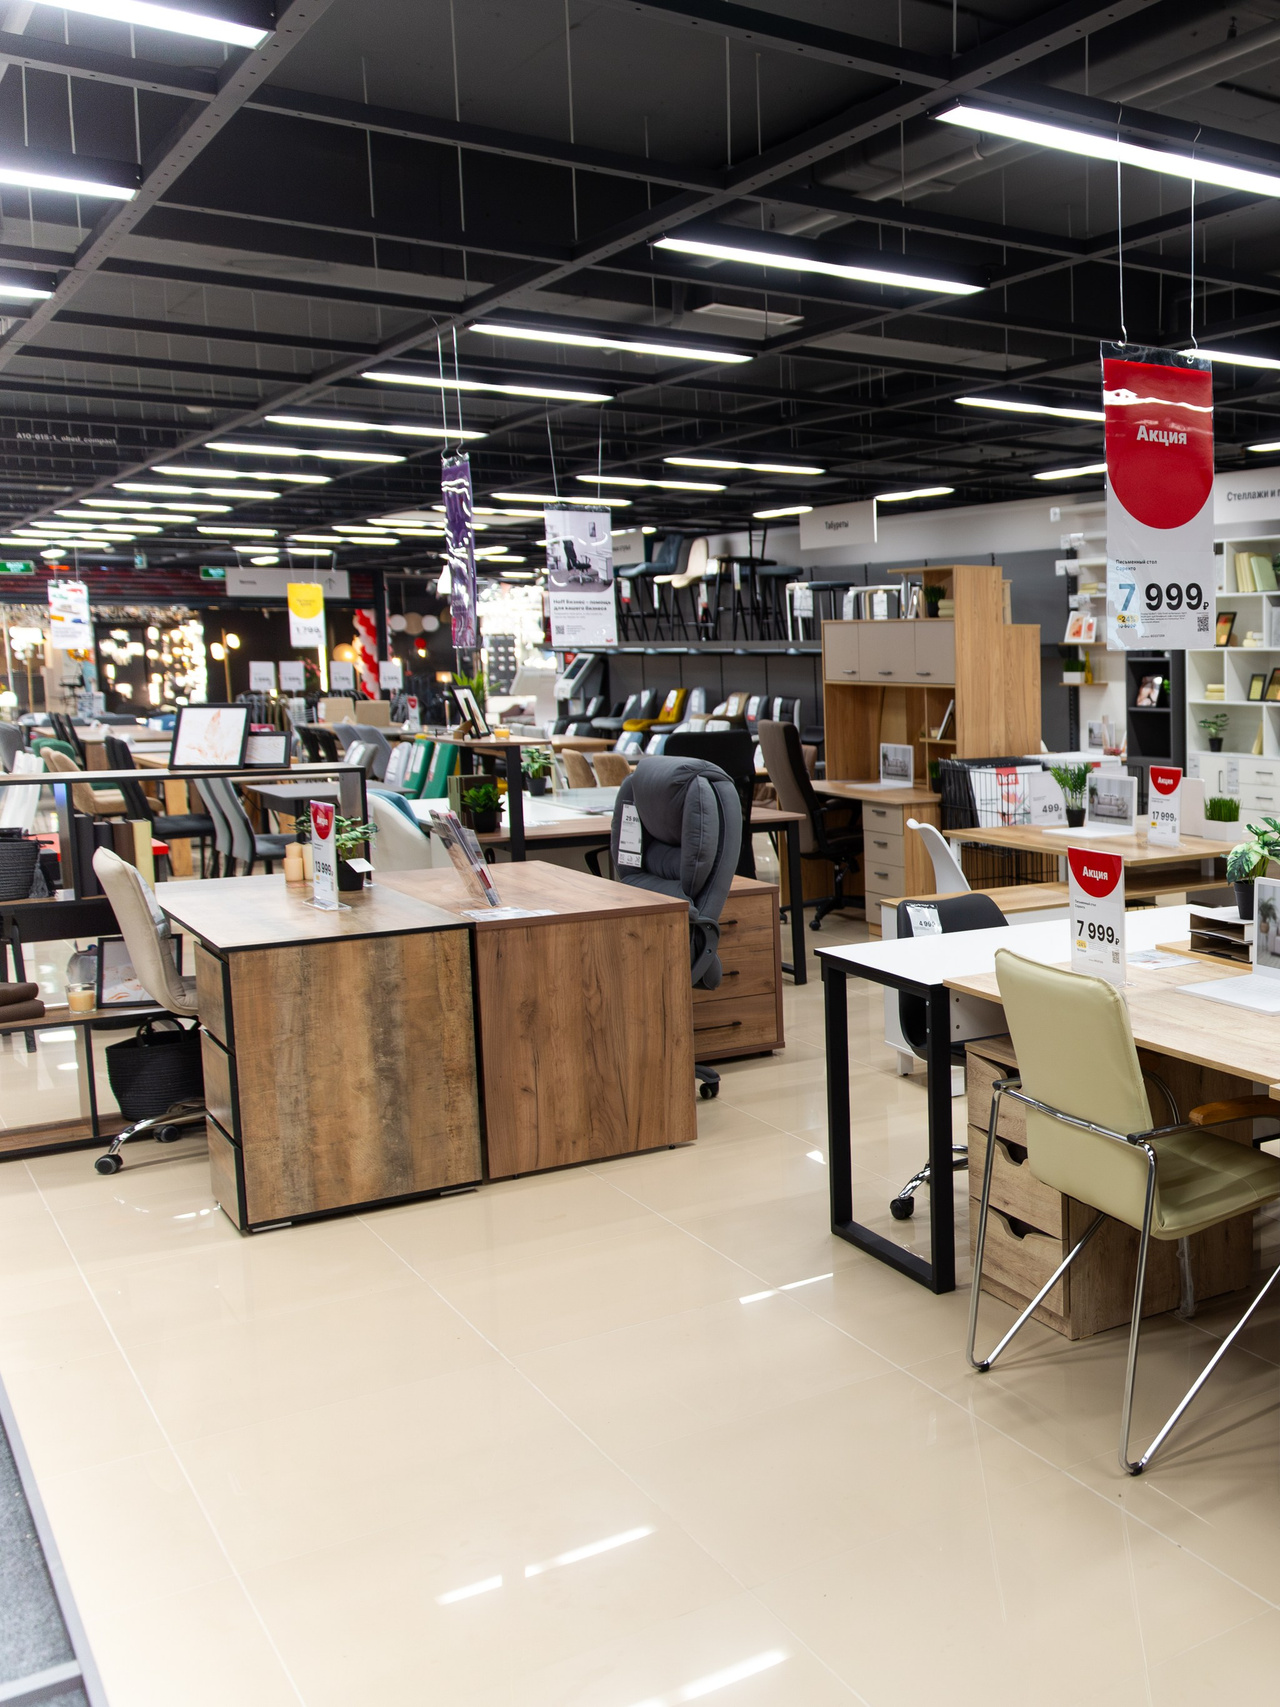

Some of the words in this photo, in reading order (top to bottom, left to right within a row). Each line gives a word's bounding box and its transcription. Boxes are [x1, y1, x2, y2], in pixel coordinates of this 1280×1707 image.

[1136, 425, 1187, 446] Акция
[1226, 490, 1269, 501] Стеллажи
[1118, 583, 1136, 611] 7
[1152, 811, 1159, 820] 17
[1082, 866, 1108, 881] Акция
[1077, 920, 1084, 936] 7
